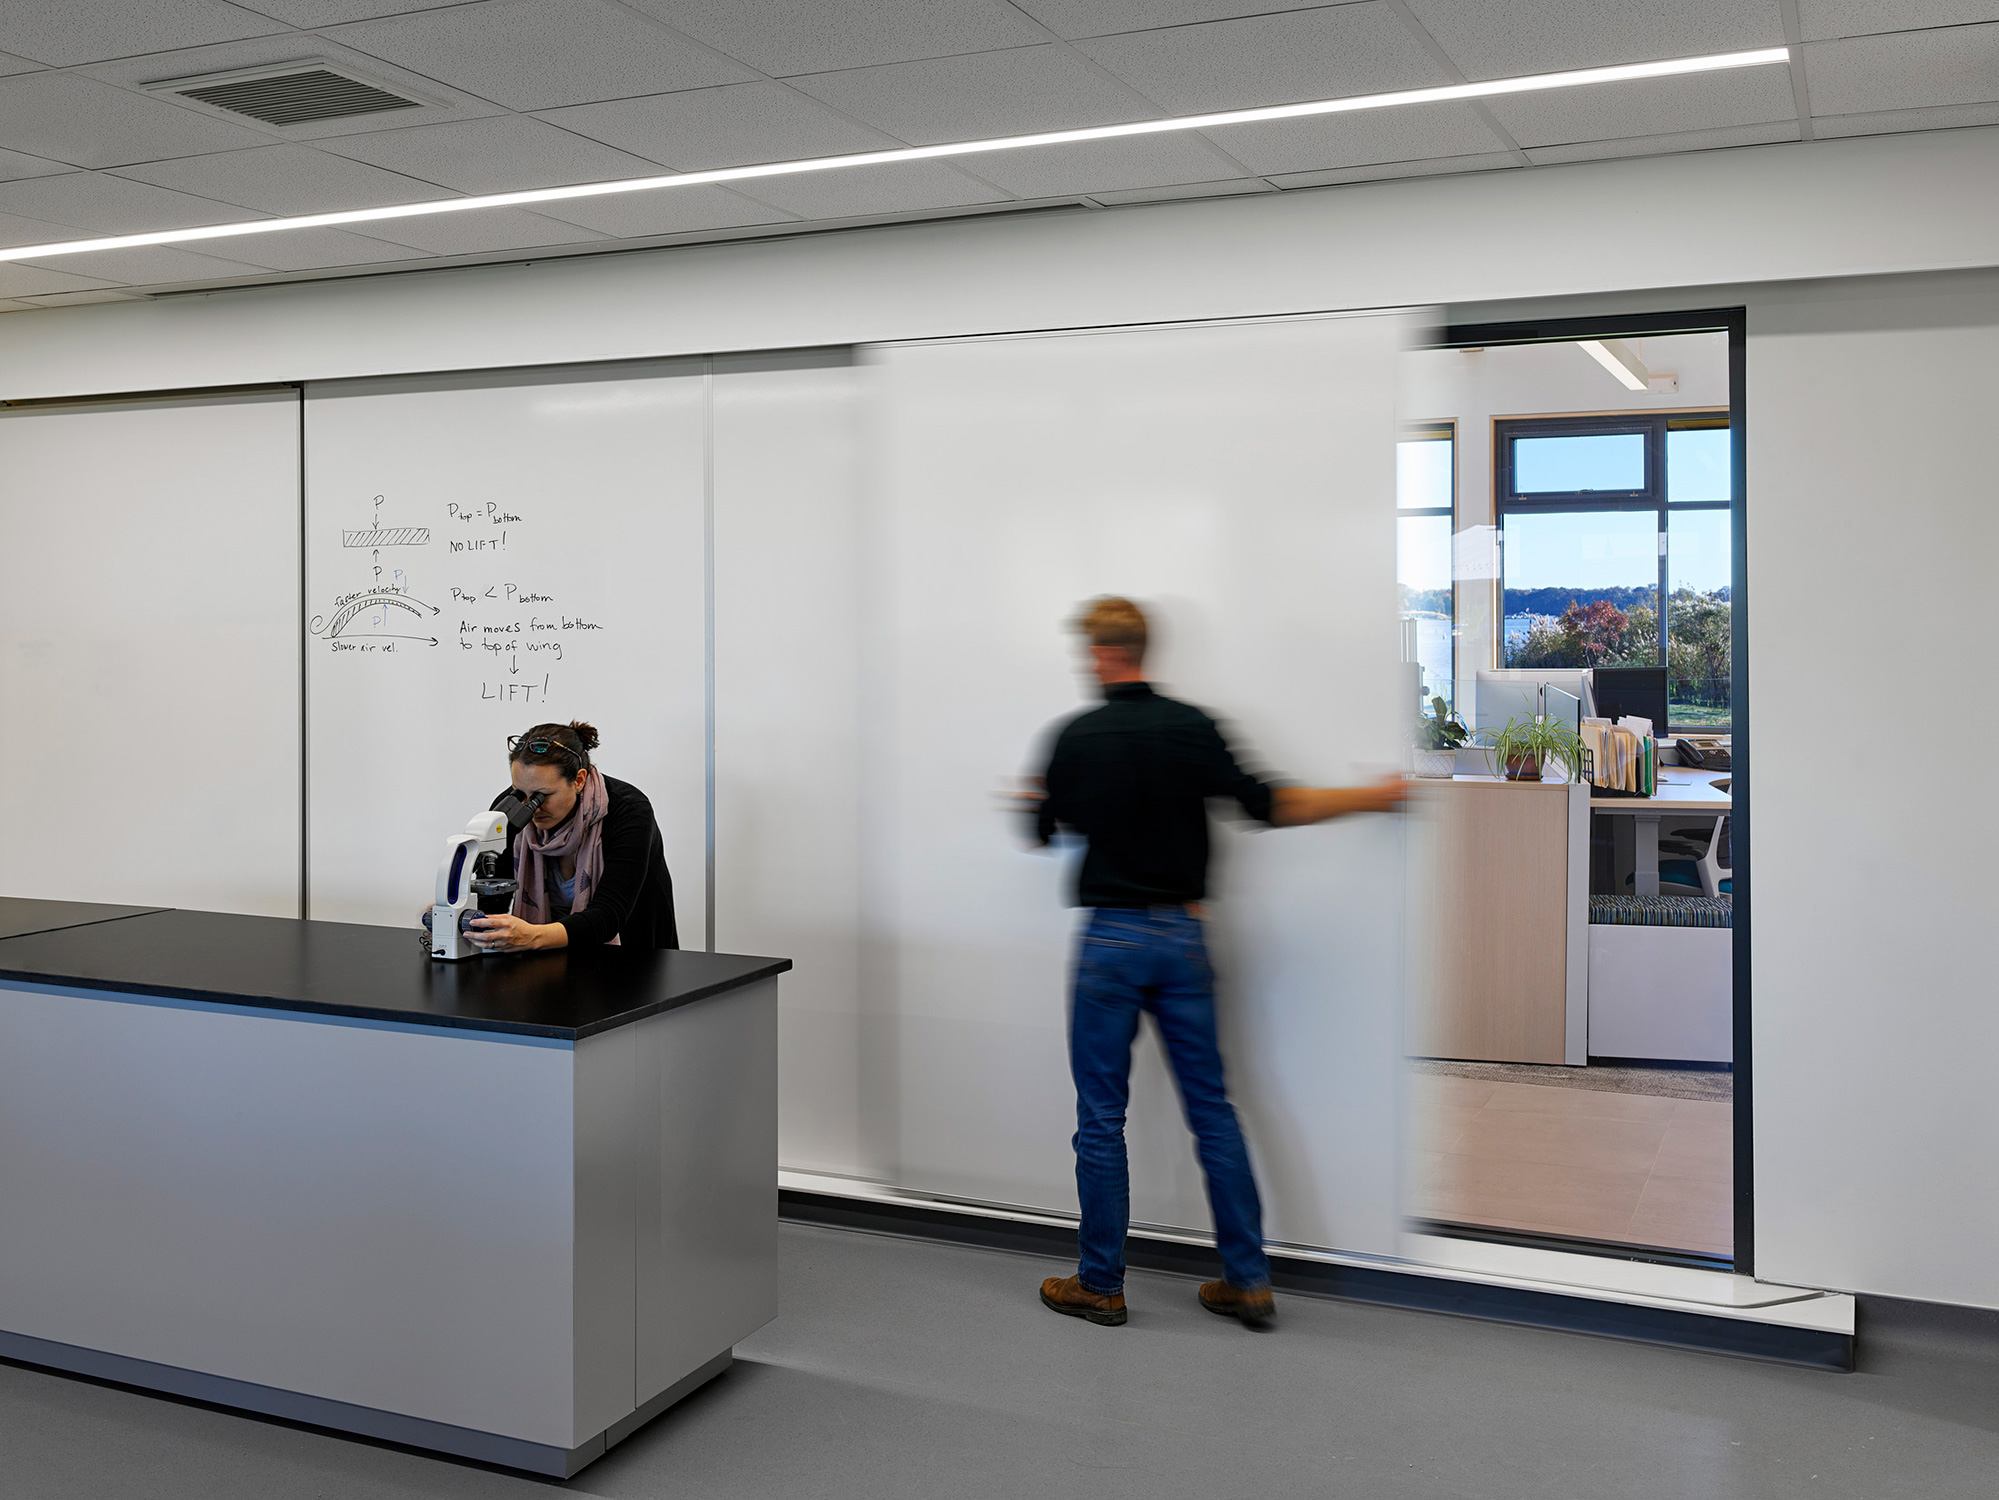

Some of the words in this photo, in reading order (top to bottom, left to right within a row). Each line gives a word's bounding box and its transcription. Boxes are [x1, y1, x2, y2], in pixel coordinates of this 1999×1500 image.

[373, 494, 385, 510] P
[372, 565, 383, 582] P
[459, 620, 478, 635] Air
[483, 622, 521, 634] moves
[529, 616, 558, 632] from
[561, 615, 604, 631] bottom
[459, 636, 473, 651] to
[481, 636, 502, 657] top
[504, 640, 518, 652] of
[526, 641, 563, 661] wing
[481, 672, 550, 704] LIFT!
